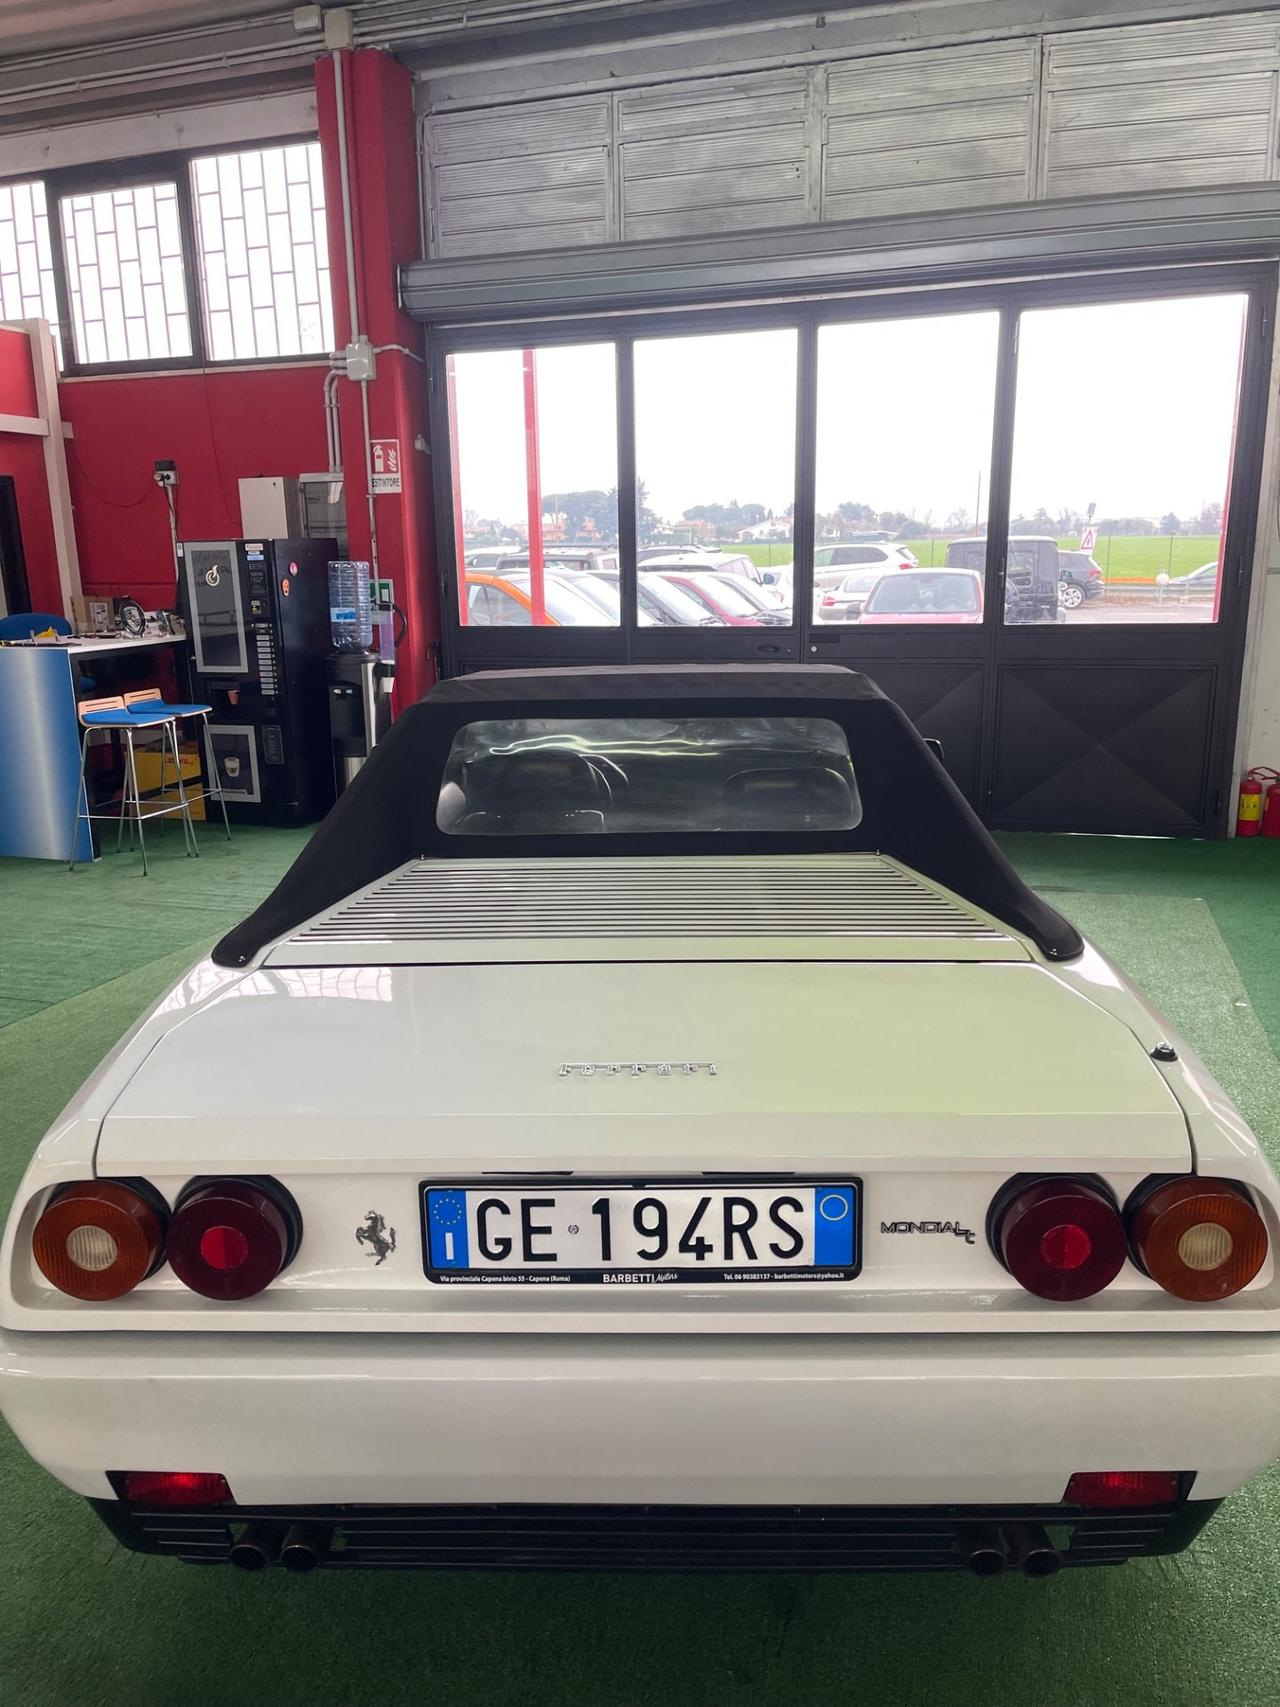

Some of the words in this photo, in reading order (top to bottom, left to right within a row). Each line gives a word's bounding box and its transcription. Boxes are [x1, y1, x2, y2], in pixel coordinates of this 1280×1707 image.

[372, 477, 400, 487] ESTINTORE
[559, 1062, 718, 1076] Ferrari
[476, 1198, 558, 1262] GE
[592, 1195, 804, 1262] 194RS
[880, 1221, 970, 1236] MONDIAL
[450, 1275, 480, 1283] provinciale
[481, 1275, 502, 1283] Capena
[529, 1275, 550, 1283] Capena
[550, 1275, 571, 1283] (Roma)
[602, 1273, 655, 1283] BARBETTI
